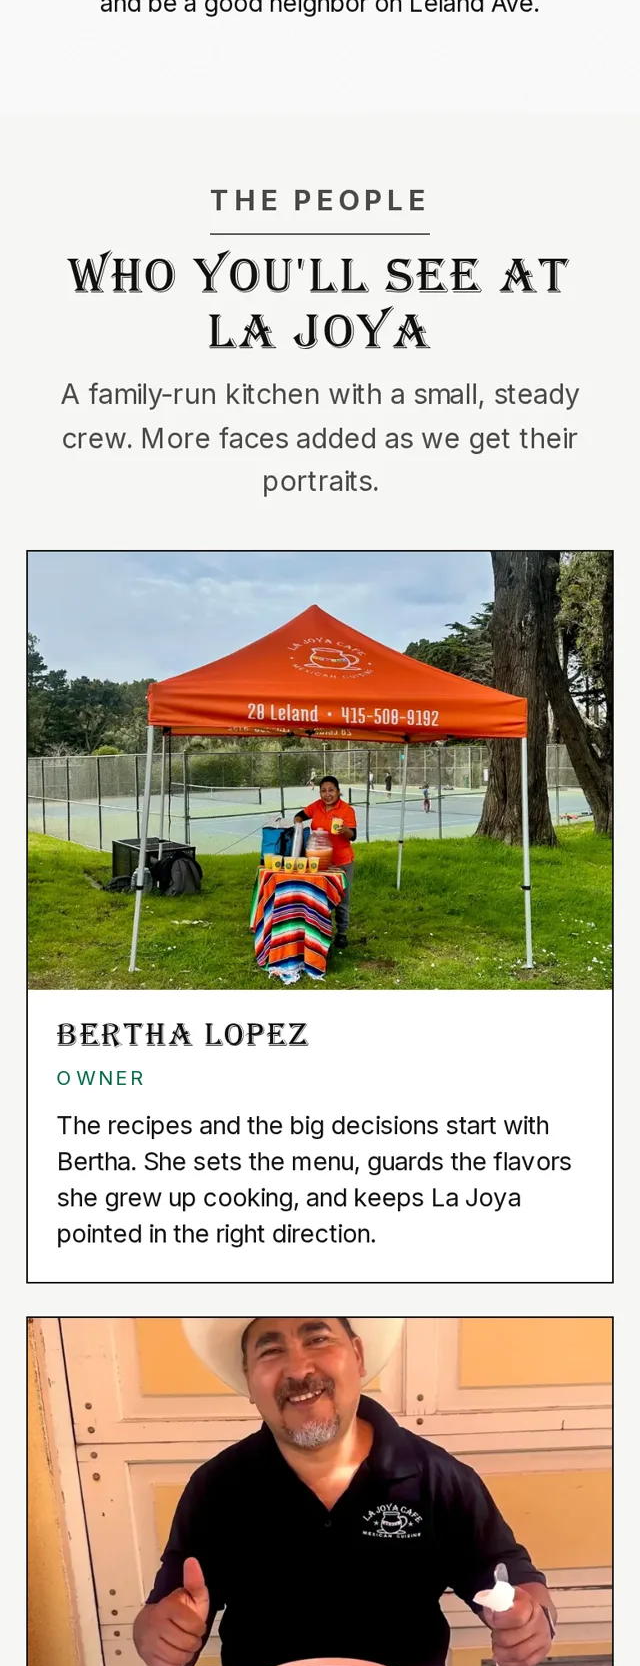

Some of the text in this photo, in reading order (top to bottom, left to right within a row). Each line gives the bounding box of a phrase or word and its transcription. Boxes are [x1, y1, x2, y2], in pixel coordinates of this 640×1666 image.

[211, 190, 424, 211] THE PEOPLE
[67, 250, 569, 293] WHO YOU'LL SEE AT
[209, 306, 431, 349] LA JOYA
[264, 470, 378, 497] portraits.
[247, 703, 440, 727] 28 Leland 415-508-9192
[57, 1023, 309, 1048] BERTHA LOPEZ
[57, 1071, 143, 1085] OWNER
[58, 1224, 375, 1248] pointed in the right direction.
[362, 1502, 423, 1523] LA JOYA CAFE
